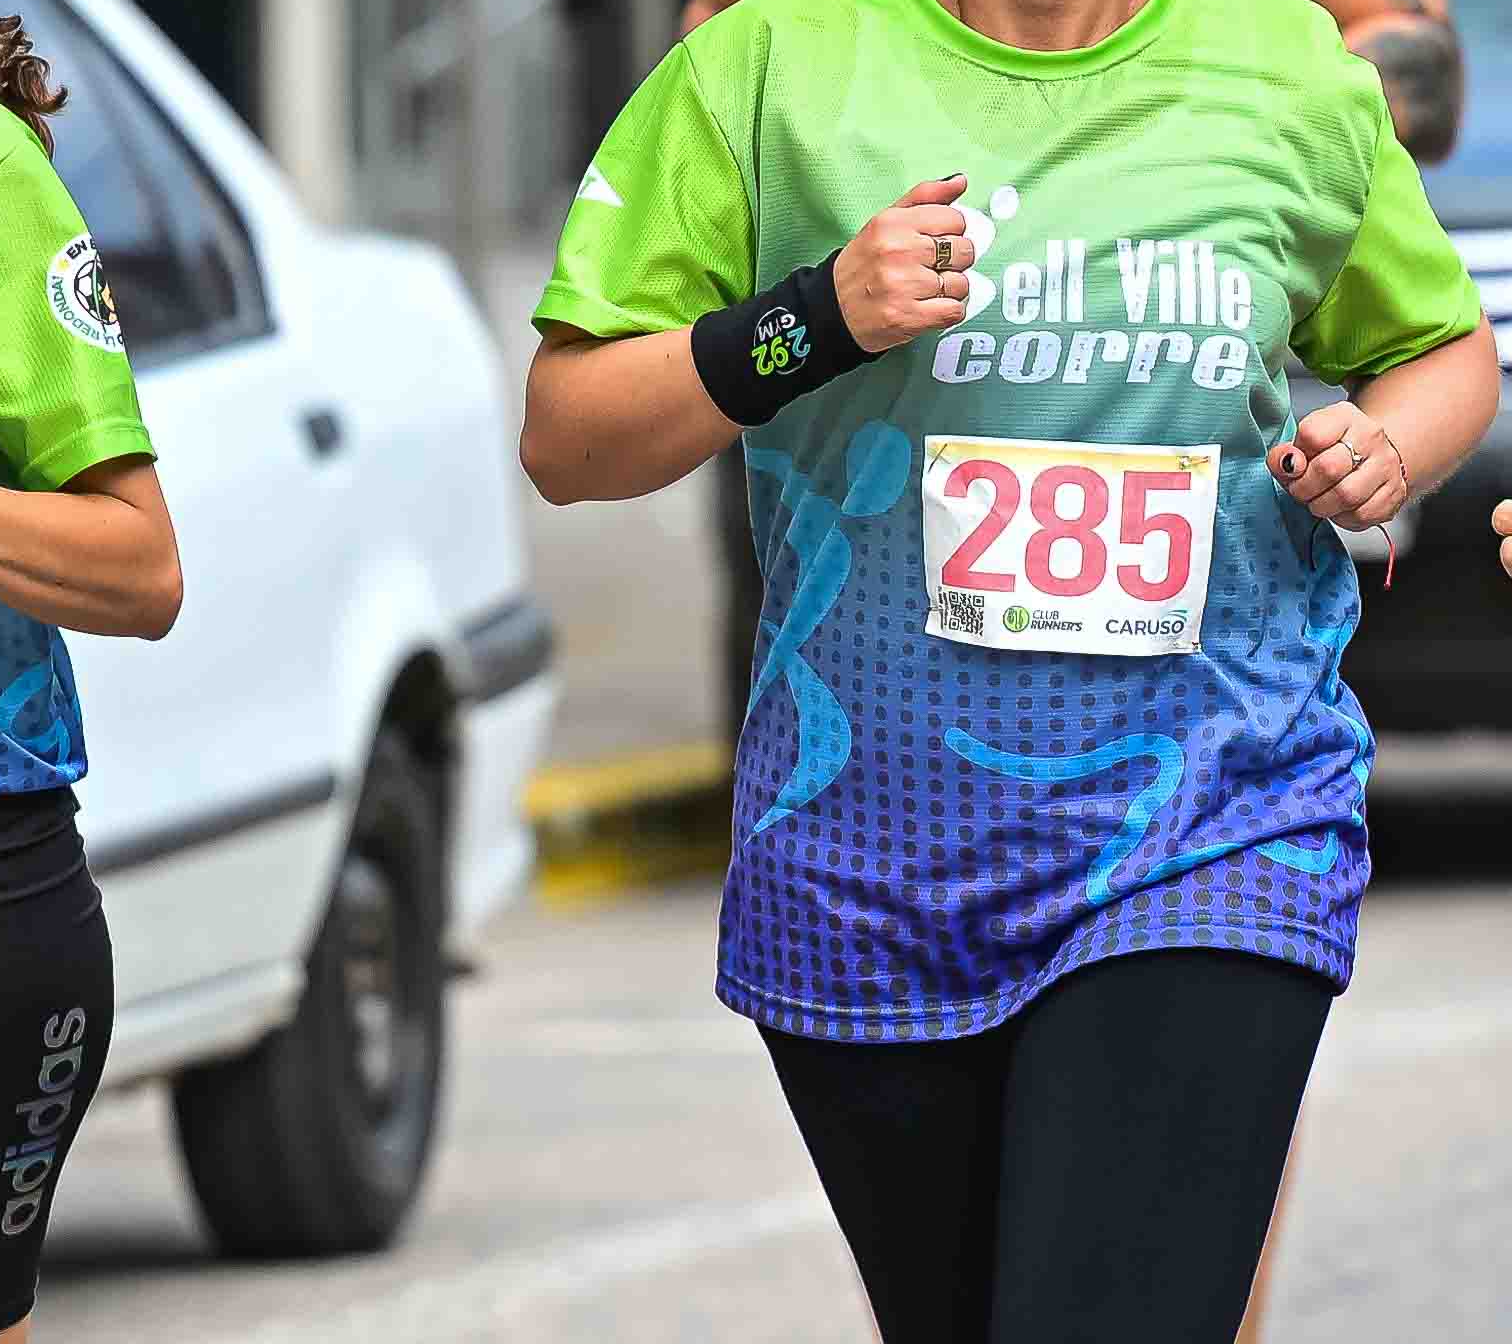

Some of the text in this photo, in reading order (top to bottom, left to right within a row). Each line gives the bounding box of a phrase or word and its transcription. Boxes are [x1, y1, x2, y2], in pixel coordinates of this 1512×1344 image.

[1115, 237, 1252, 330] Ville
[758, 313, 796, 342] GYM
[931, 331, 1249, 390] corre
[940, 459, 1194, 603] 285
[1032, 609, 1060, 620] CLUB
[1104, 618, 1186, 637] CARUSO
[0, 1006, 87, 1235] adidas
